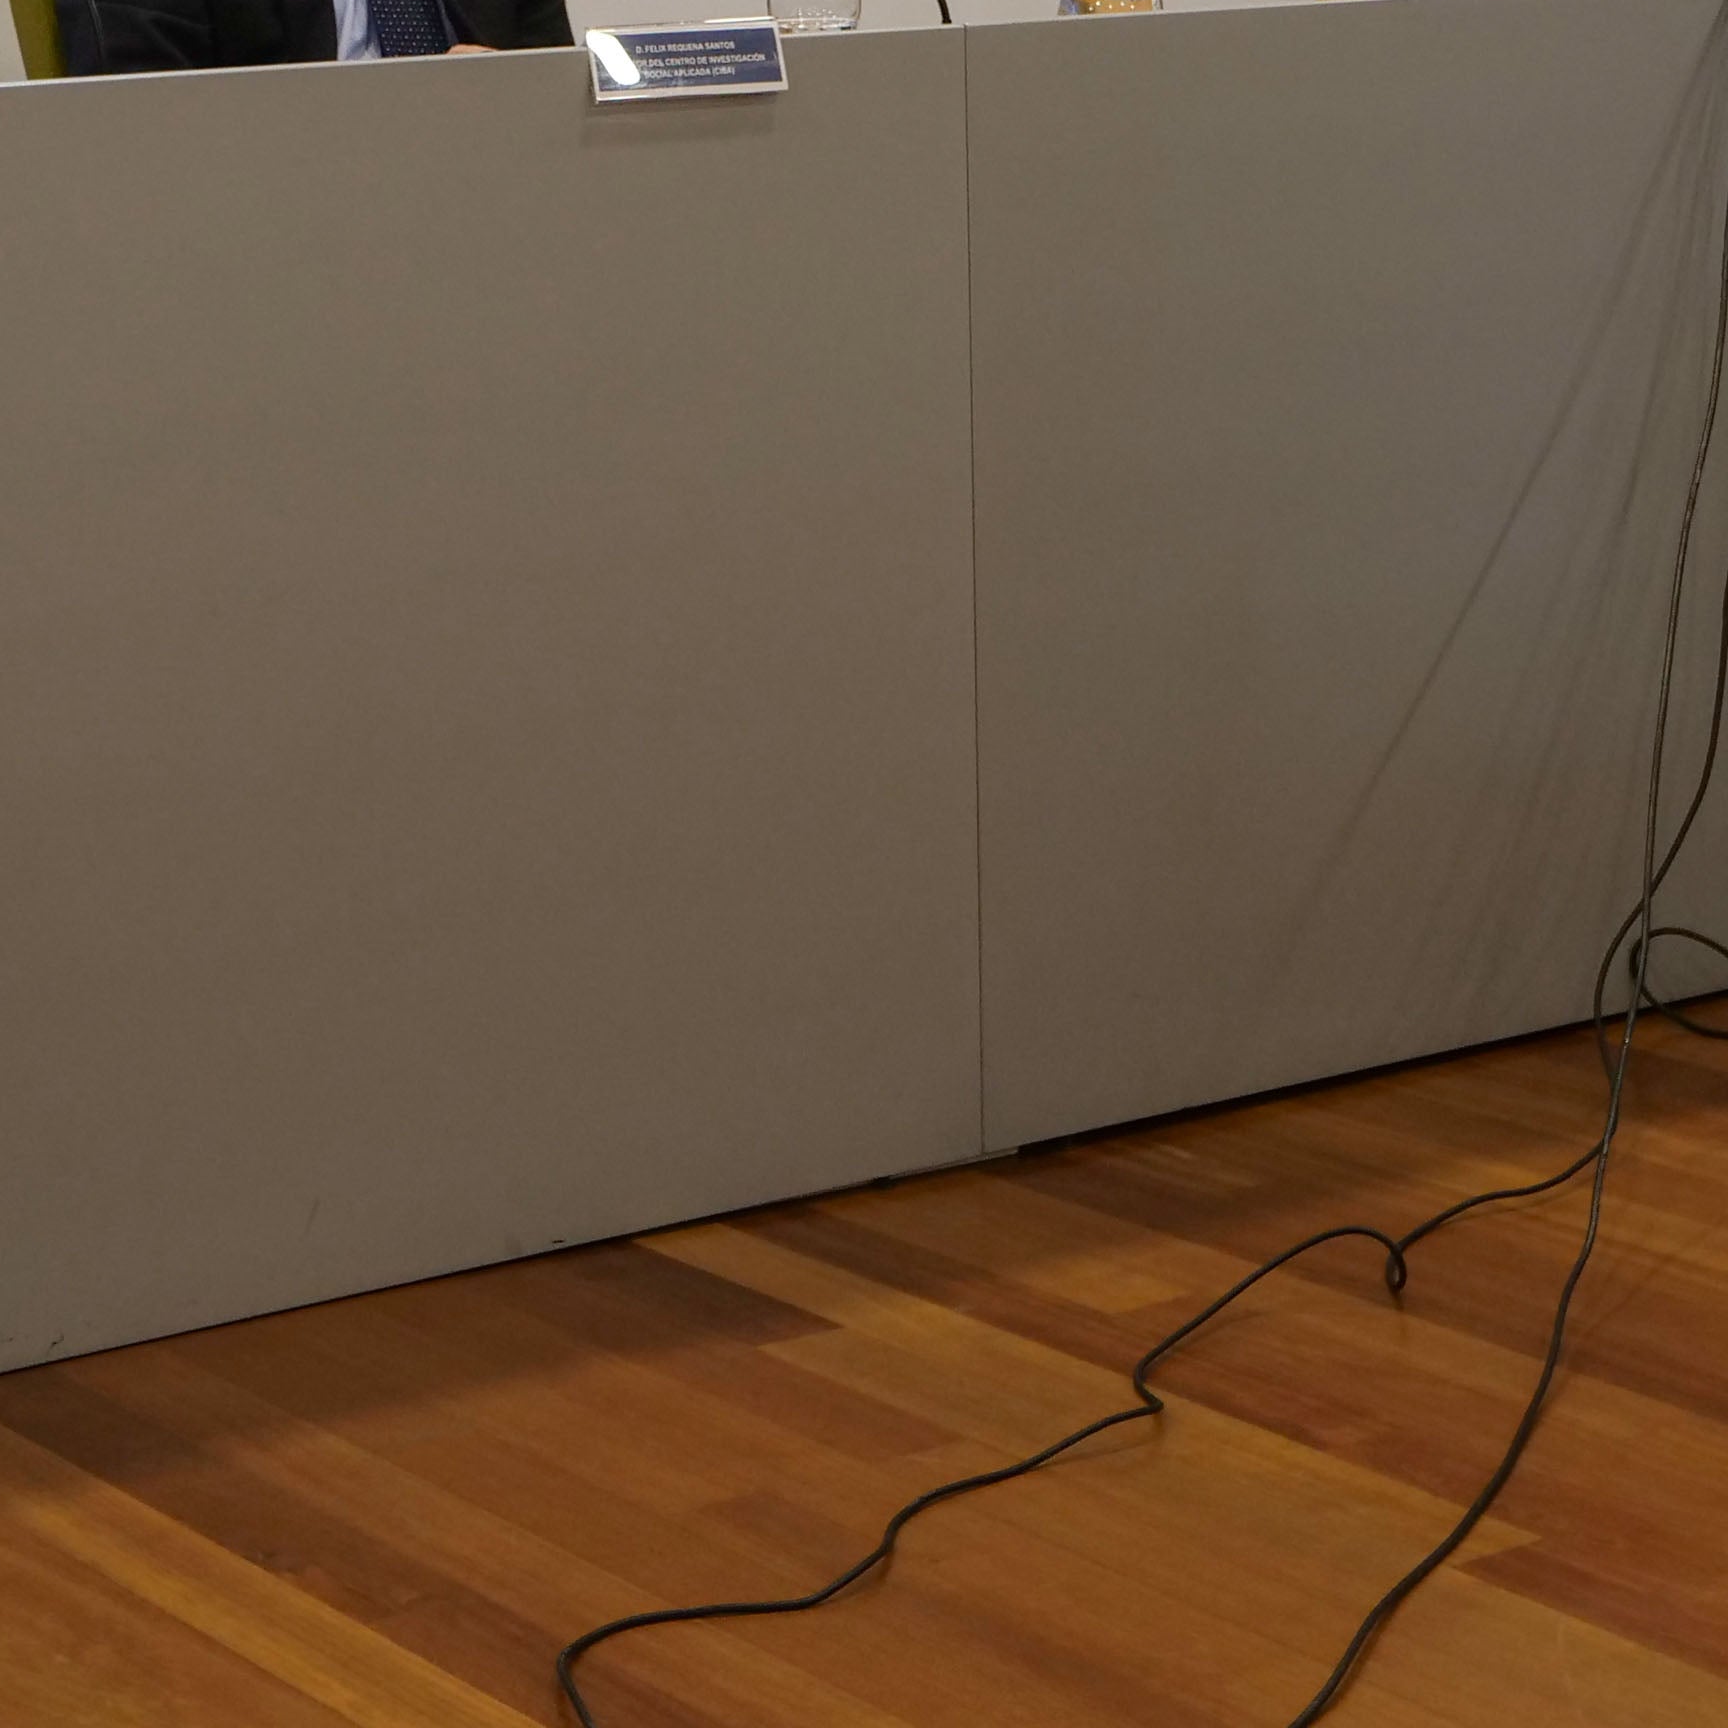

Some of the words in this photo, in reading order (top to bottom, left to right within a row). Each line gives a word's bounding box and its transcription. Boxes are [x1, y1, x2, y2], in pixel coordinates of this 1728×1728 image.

[635, 46, 644, 55] D.
[645, 44, 667, 54] FELIX
[667, 41, 704, 52] REQUENA
[705, 40, 735, 50] SANTOS
[665, 56, 696, 66] CENTRO
[697, 55, 708, 65] DE
[709, 52, 766, 65] INVESTIGACIÓN
